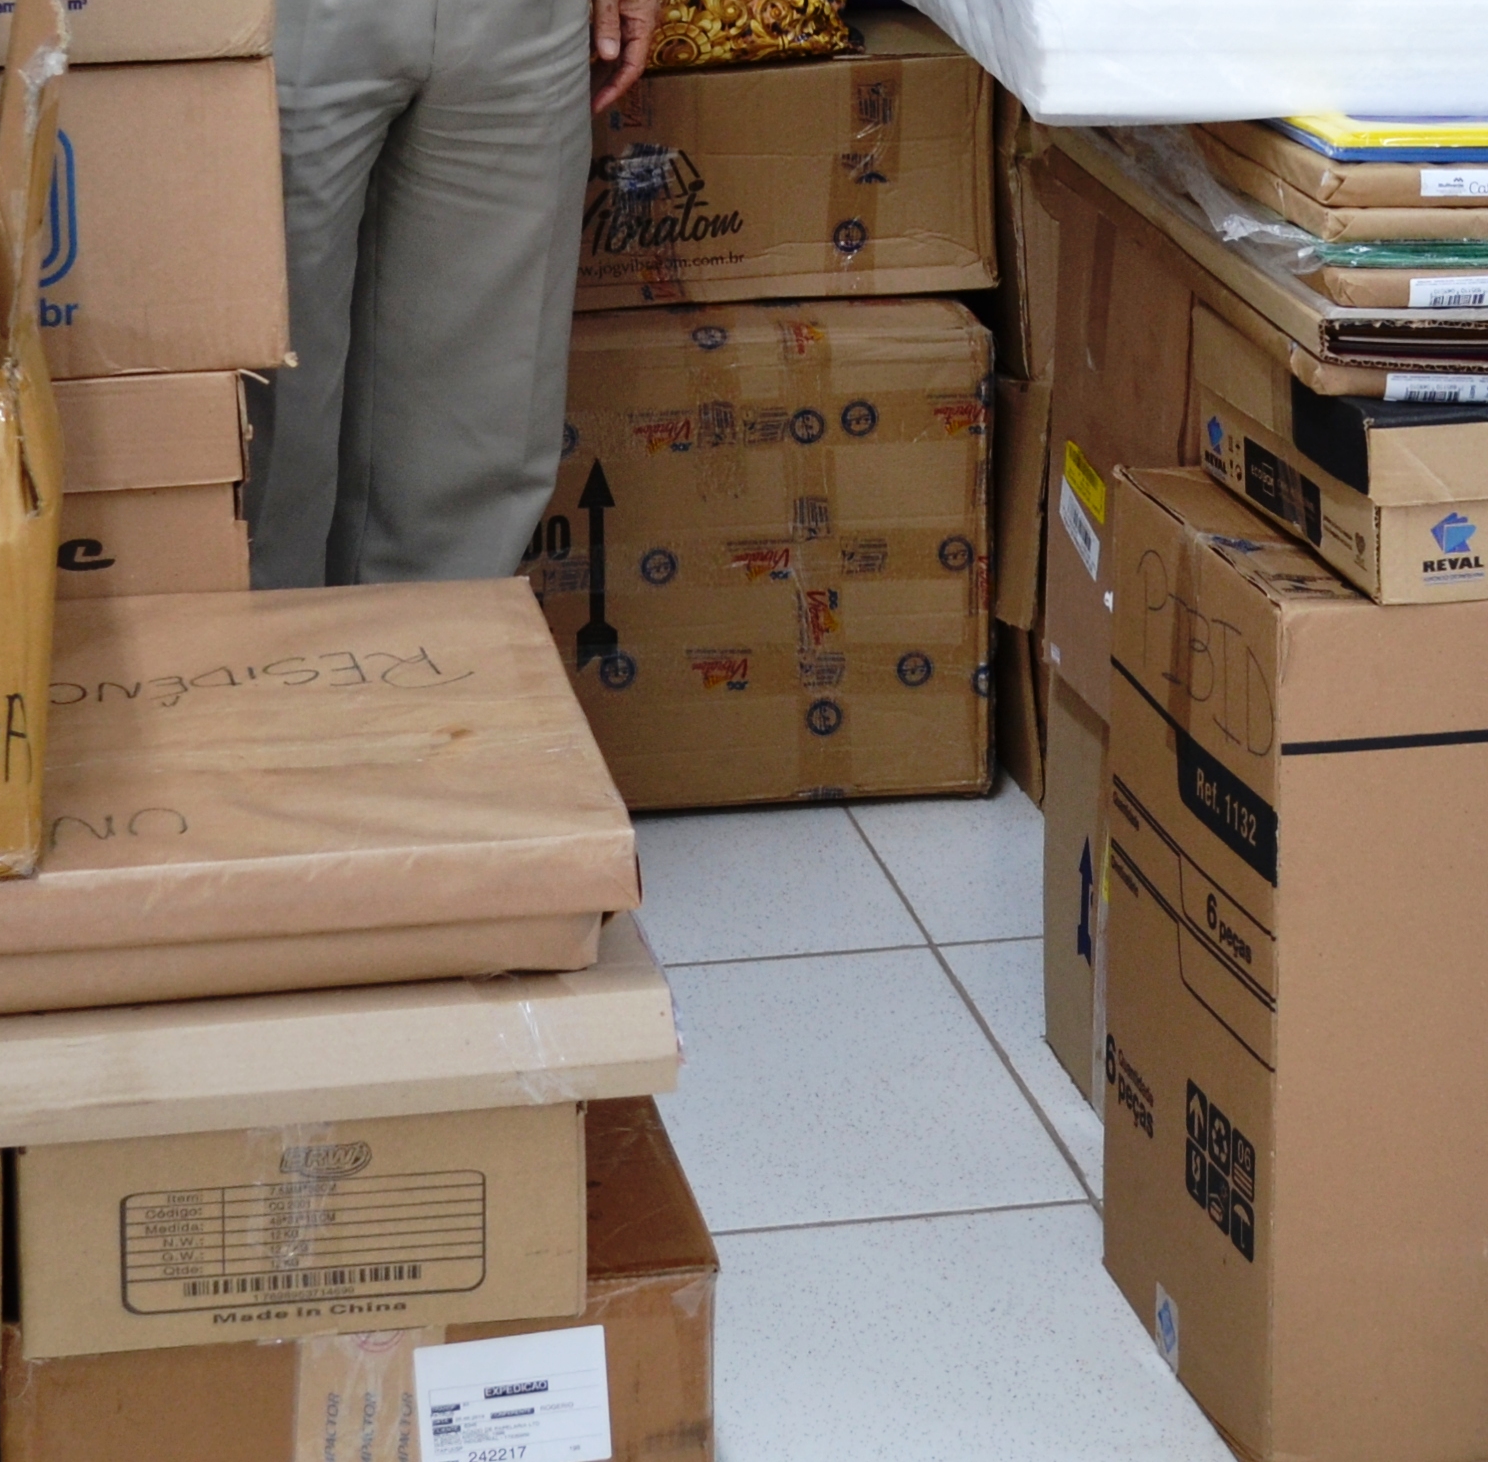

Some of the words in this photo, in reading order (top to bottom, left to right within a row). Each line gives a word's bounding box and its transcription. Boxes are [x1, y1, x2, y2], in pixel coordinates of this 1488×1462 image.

[1422, 556, 1485, 574] REVAL
[1136, 549, 1275, 757] PIBID
[1196, 767, 1220, 815] Ref.
[1225, 793, 1257, 848] 1132
[1206, 892, 1218, 931] 6
[1219, 919, 1253, 966] peças
[1116, 1075, 1154, 1139] peças
[167, 1192, 204, 1204] Item:
[145, 1205, 203, 1222] Código:
[145, 1222, 204, 1236] Medida:
[213, 1308, 289, 1325] Made
[297, 1305, 322, 1319] in
[330, 1300, 408, 1317] China
[468, 1445, 528, 1462] 242217
